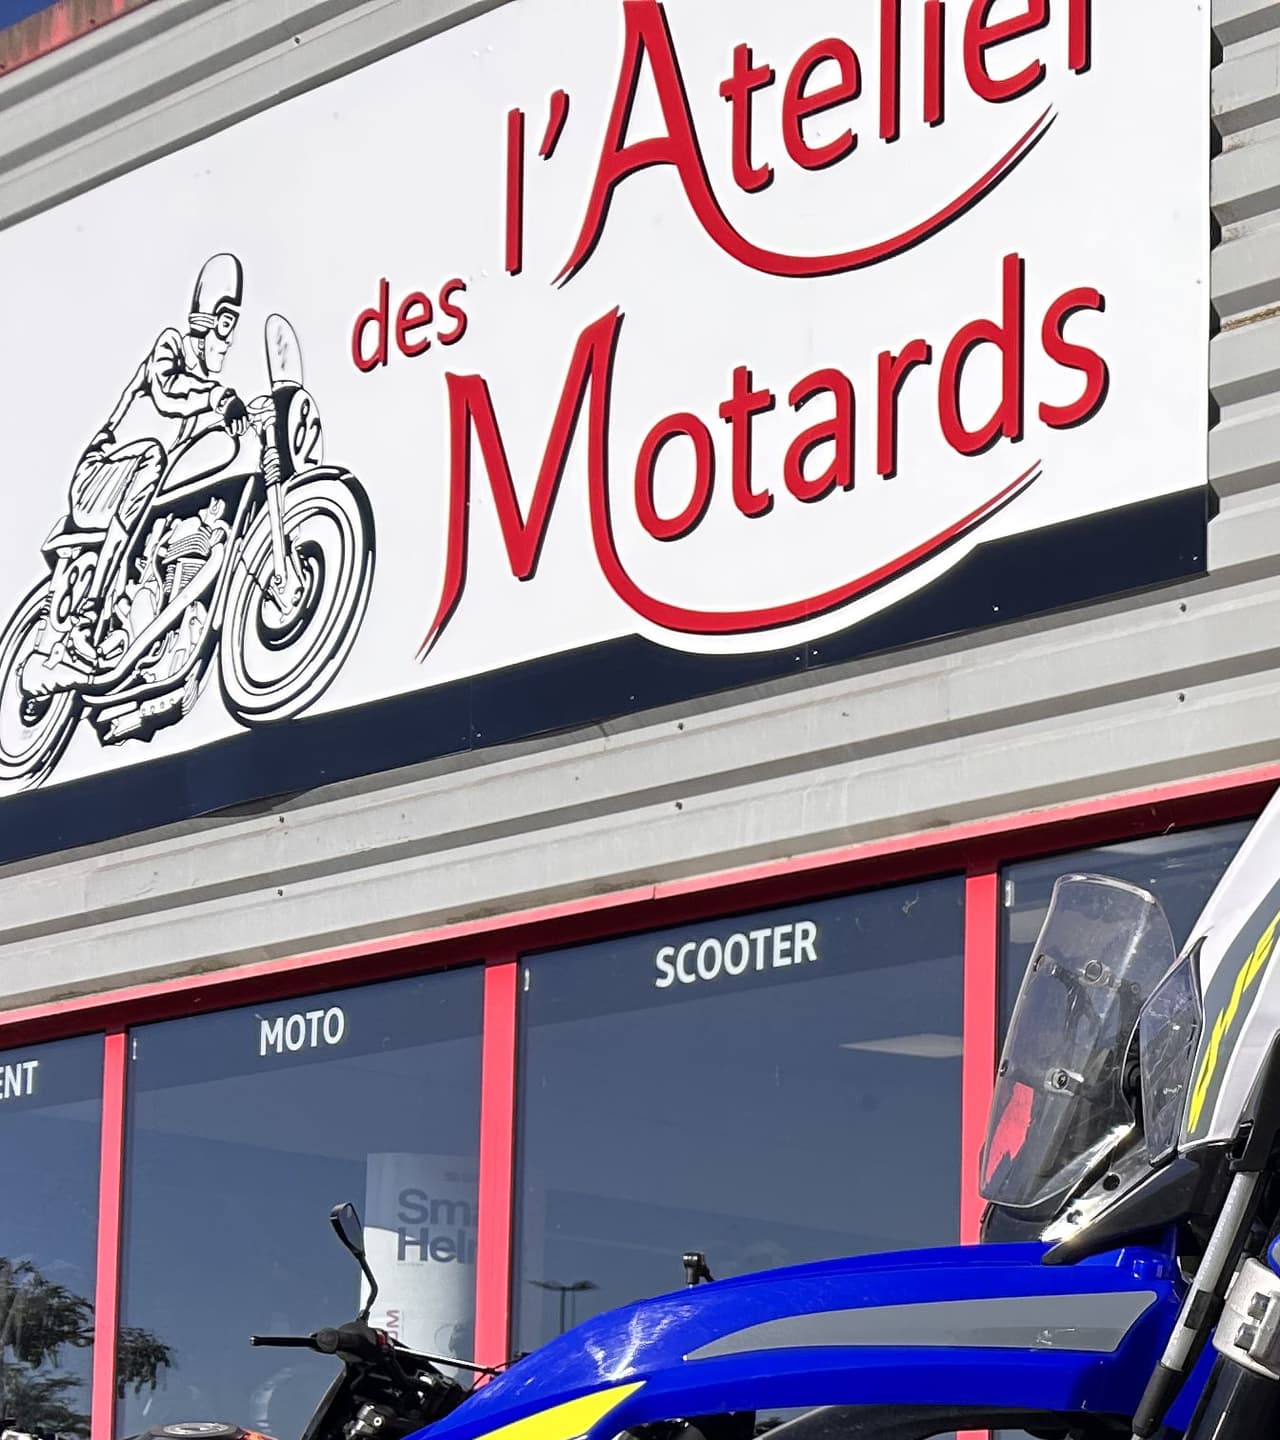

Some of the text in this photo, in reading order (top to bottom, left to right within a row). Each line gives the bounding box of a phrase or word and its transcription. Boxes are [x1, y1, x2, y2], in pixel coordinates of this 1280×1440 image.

[350, 276, 469, 373] des
[418, 253, 1110, 661] Motards
[655, 920, 817, 989] SCOOTER
[259, 1006, 345, 1056] MOTO
[397, 1187, 479, 1226] Sm
